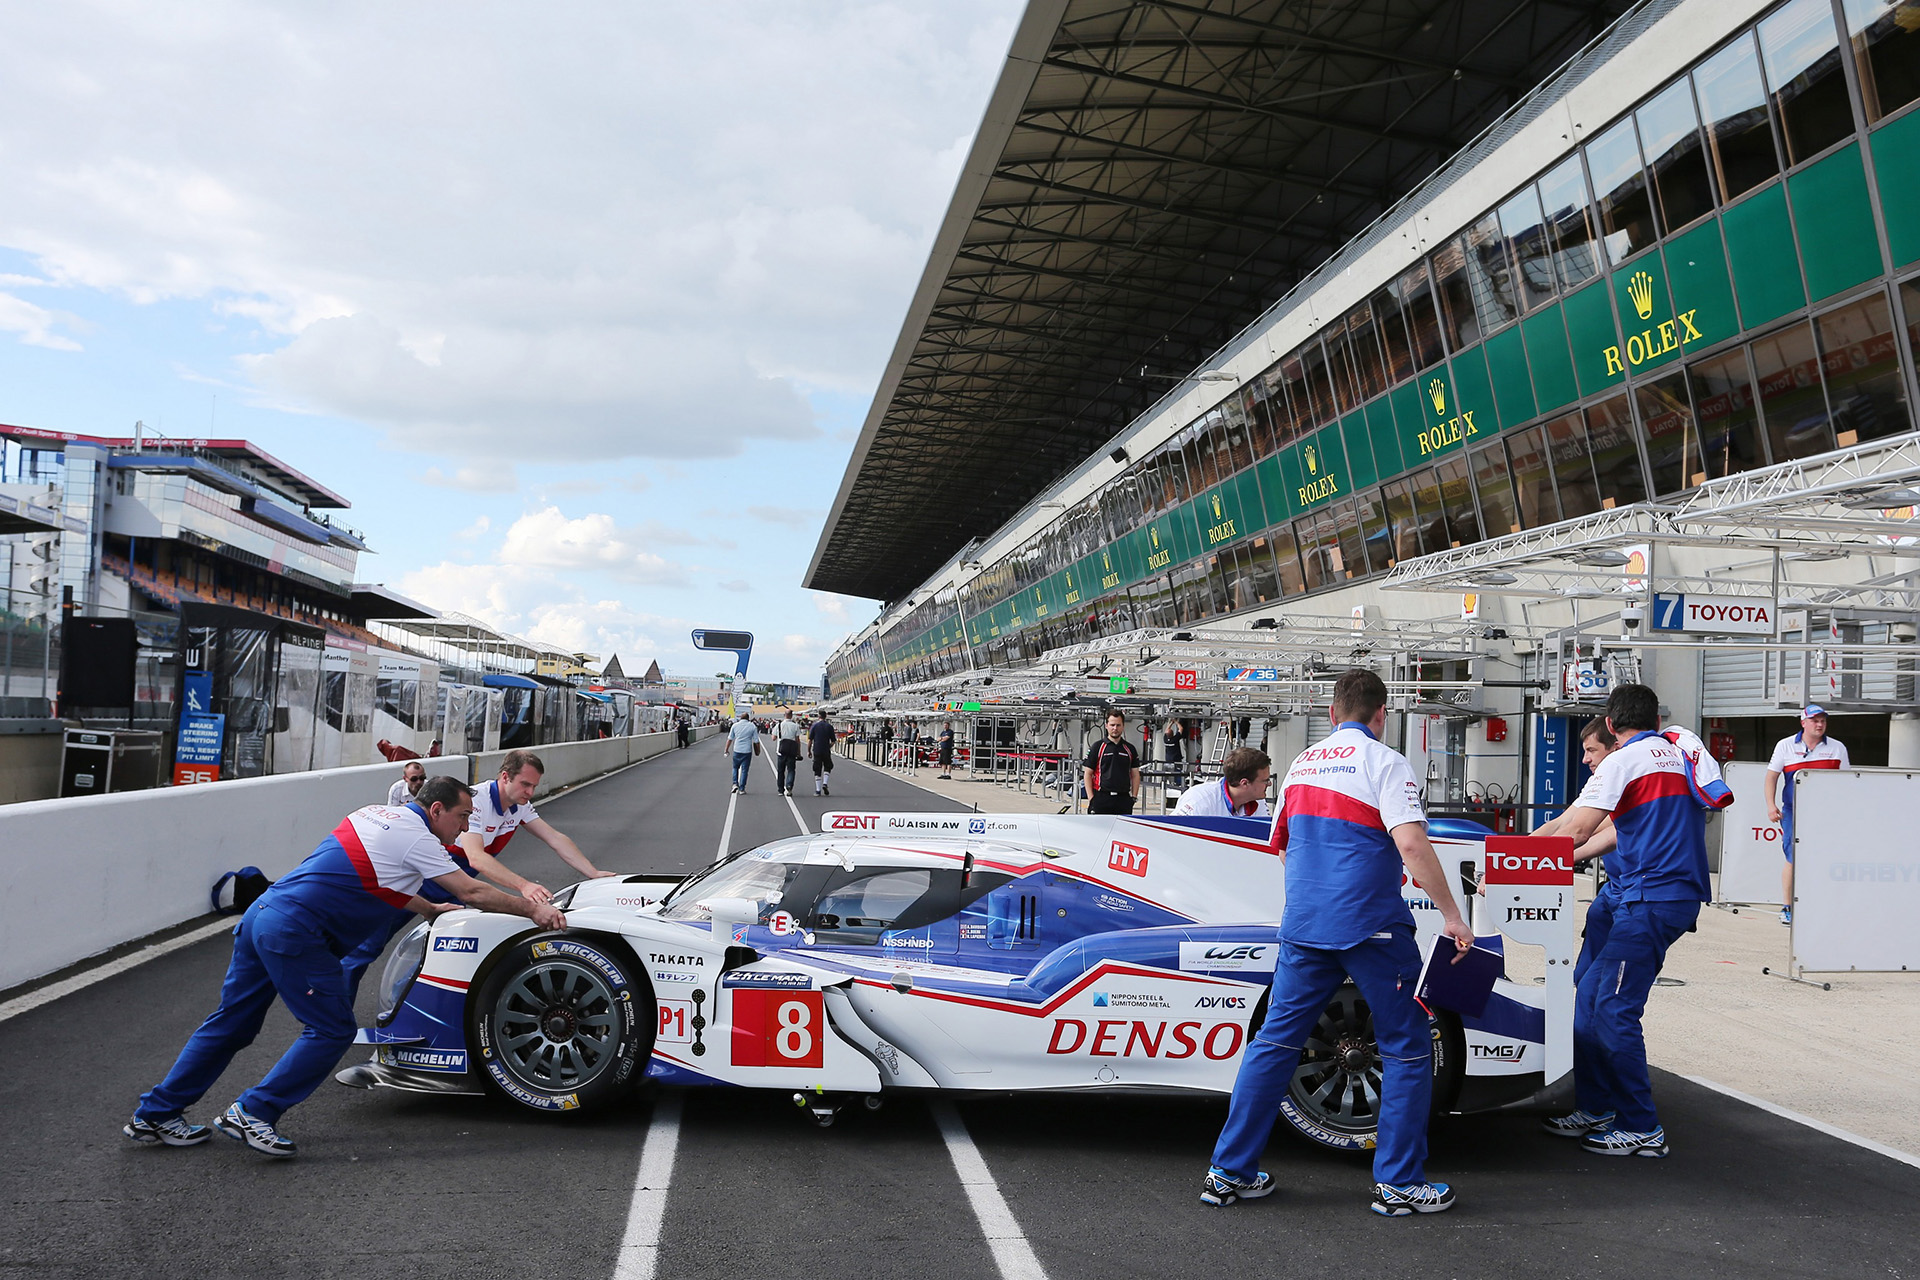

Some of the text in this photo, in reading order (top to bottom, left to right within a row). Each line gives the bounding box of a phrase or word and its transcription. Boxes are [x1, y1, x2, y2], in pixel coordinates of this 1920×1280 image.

[1603, 309, 1702, 376] ROLEX
[1417, 410, 1478, 455] ROLEX
[1298, 473, 1338, 506] ROLEX
[1208, 520, 1237, 544] ROLEX
[1148, 549, 1171, 570] ROLEX
[1102, 572, 1120, 589] ROLEX
[1658, 594, 1769, 627] 7 TOYOTA
[1177, 673, 1194, 686] 92
[1256, 670, 1275, 679] 36
[1112, 679, 1127, 691] 91
[1296, 746, 1356, 764] DENSO
[180, 771, 211, 783] 36
[1291, 766, 1356, 779] TOYOTA HYBRID
[1544, 732, 1555, 823] ALPINE
[832, 815, 880, 829] ZENT
[906, 821, 939, 829] AISIN
[1110, 844, 1147, 870] HY
[1486, 852, 1574, 871] TOTAL
[1108, 896, 1128, 905] ACTION
[775, 916, 787, 931] E
[1505, 907, 1560, 923] JTEKT
[436, 939, 475, 950] AISIN
[1204, 945, 1267, 960] WEC
[559, 943, 625, 985] MICHELIN
[649, 953, 704, 966] TAKATA
[1194, 997, 1246, 1008] ADVICS
[659, 1006, 684, 1037] P1
[776, 1000, 812, 1059] 8
[1047, 1018, 1244, 1061] DENSO
[397, 1050, 464, 1066] MICHELIN
[1469, 1045, 1514, 1057] TMG
[489, 1063, 551, 1108] MICHELIN
[1280, 1100, 1350, 1147] MICHELIN
